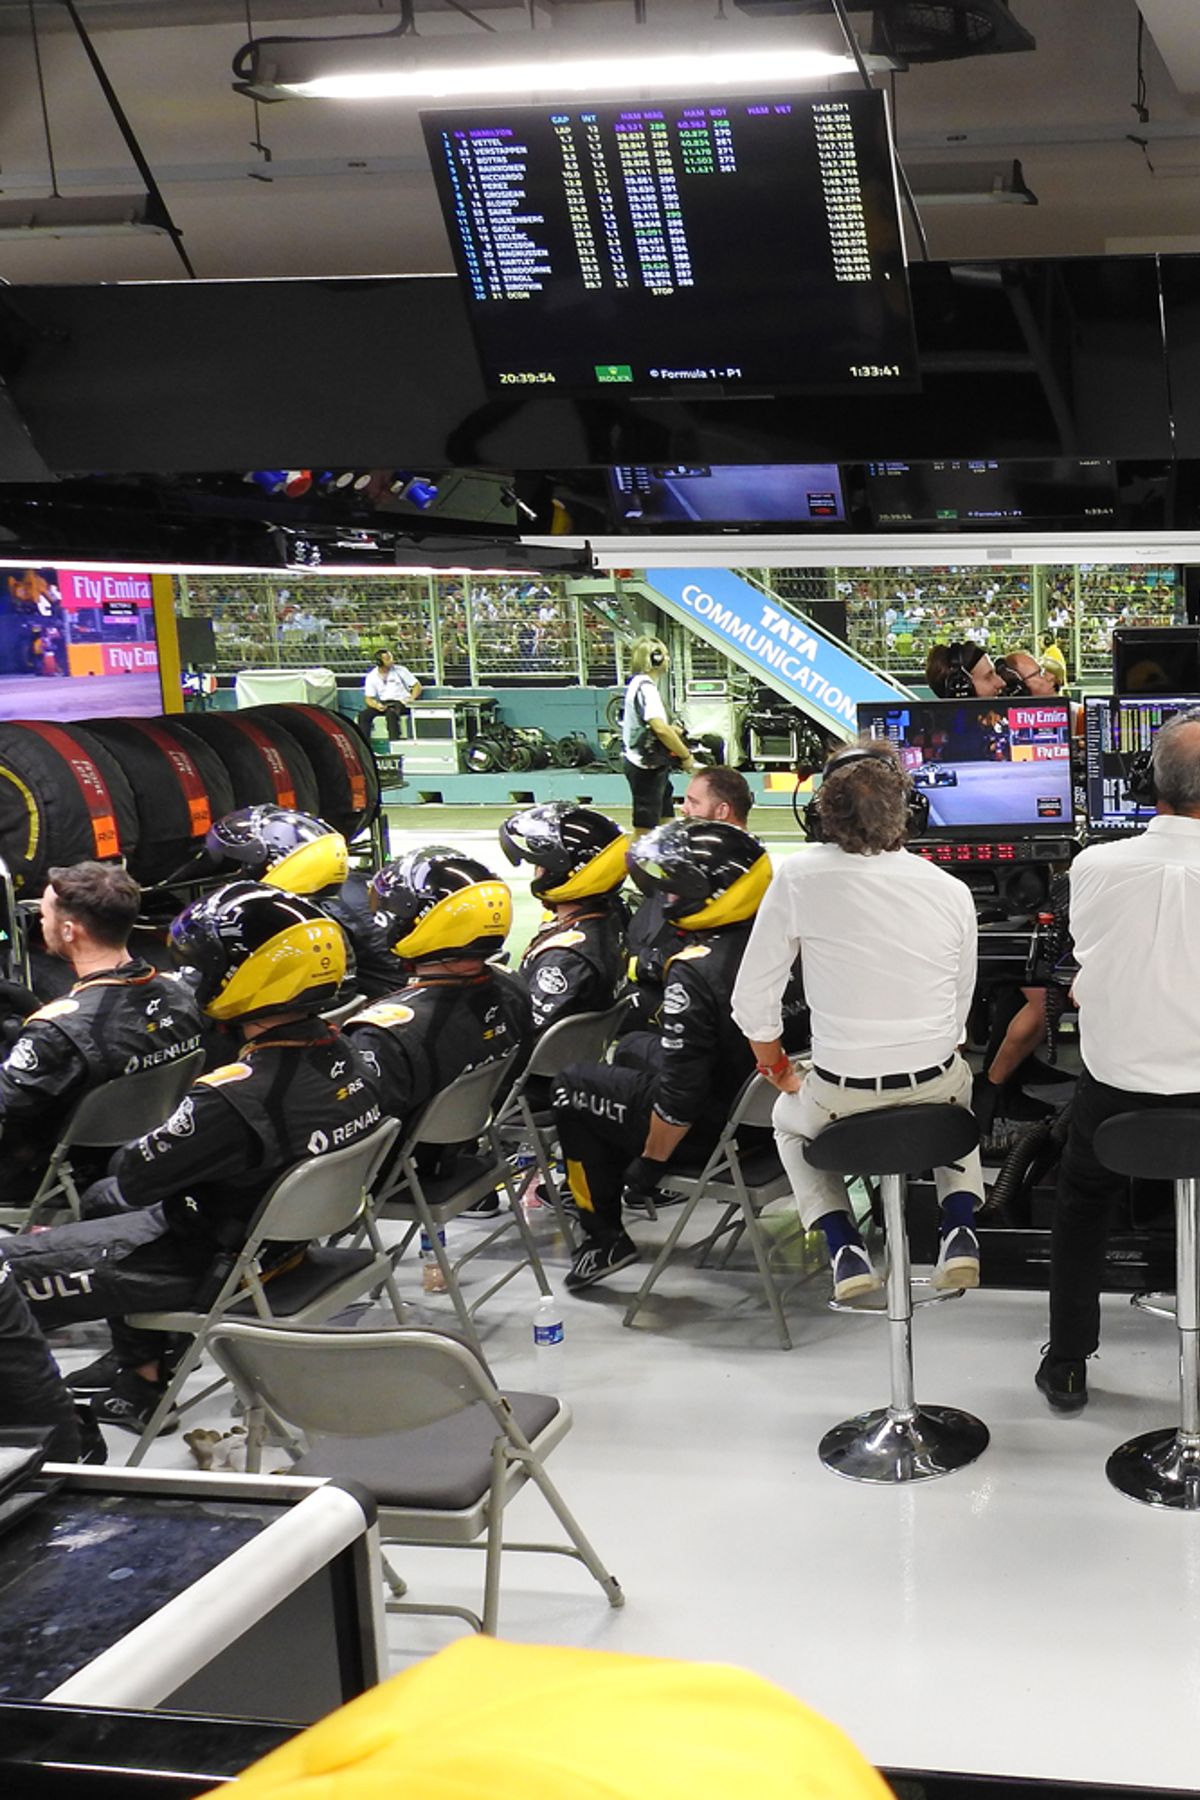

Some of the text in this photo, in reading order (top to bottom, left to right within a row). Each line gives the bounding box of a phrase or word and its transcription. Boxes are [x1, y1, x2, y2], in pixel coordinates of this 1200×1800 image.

[499, 372, 556, 384] 20:39:54
[661, 368, 708, 379] Formula
[727, 368, 742, 378] P1
[849, 365, 900, 377] 1:33:41
[73, 575, 101, 604] Fly
[759, 605, 819, 662] TATA
[109, 648, 133, 670] Fly
[681, 584, 858, 724] COMMUNICATION
[1016, 711, 1035, 726] Fly
[1037, 747, 1053, 758] Fly
[143, 1034, 201, 1069] RENAULT
